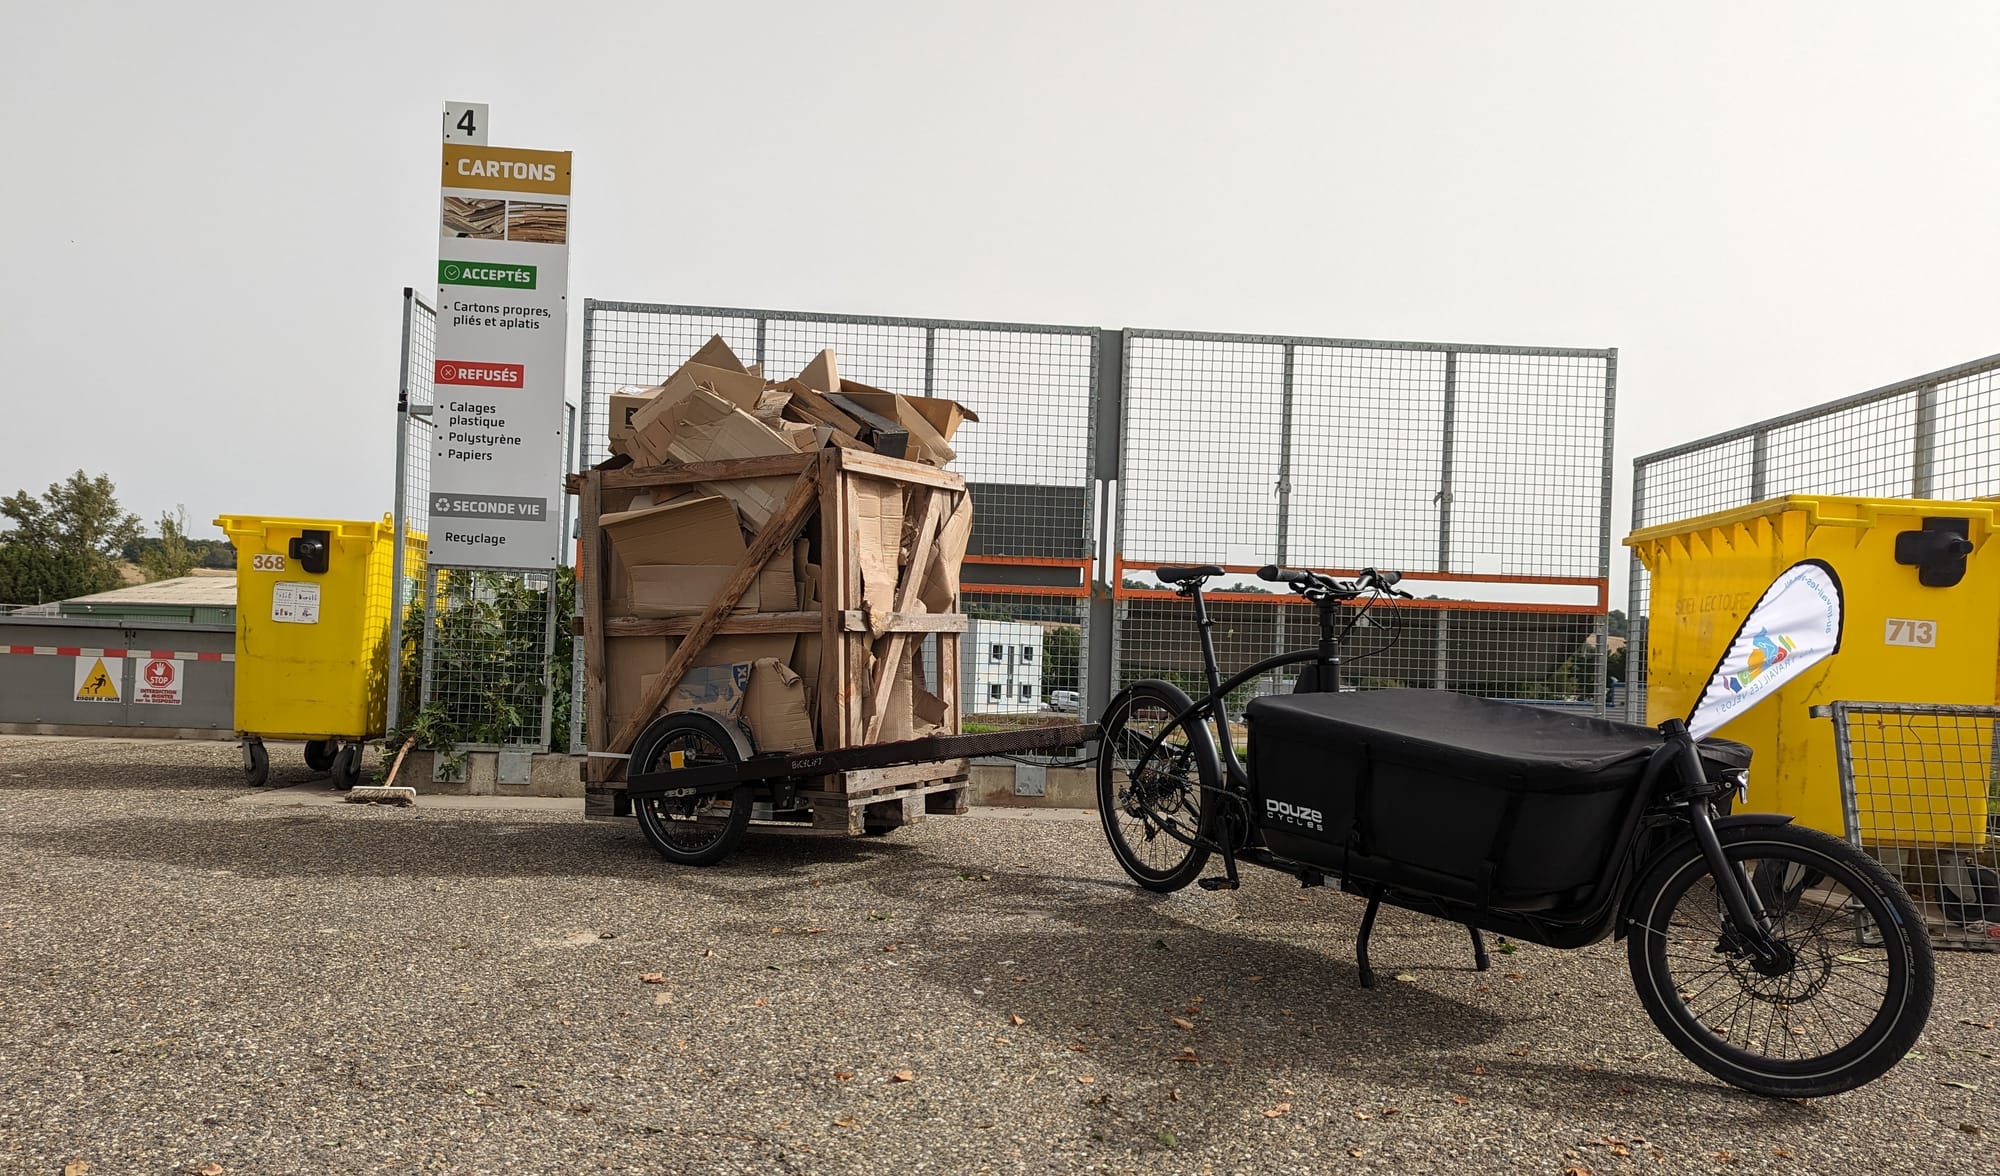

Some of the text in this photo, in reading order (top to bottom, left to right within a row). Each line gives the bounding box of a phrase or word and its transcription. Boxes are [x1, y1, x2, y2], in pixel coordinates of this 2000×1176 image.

[457, 109, 476, 136] 4
[457, 158, 556, 182] CARTONS
[462, 267, 531, 283] ACCEPTÉS
[453, 301, 552, 318] Cartons propres,
[453, 314, 540, 330] pliés et aplatis
[458, 367, 518, 382] REFUSÉS
[449, 402, 496, 414] Calages
[449, 415, 506, 428] plastique
[448, 432, 522, 446] Polystyrène
[448, 449, 493, 462] Papiers
[453, 500, 540, 515] SECONDE VIE
[445, 532, 507, 546] Recyclage
[253, 555, 285, 570] 368
[1888, 620, 1933, 644] 713
[150, 676, 169, 684] STOP
